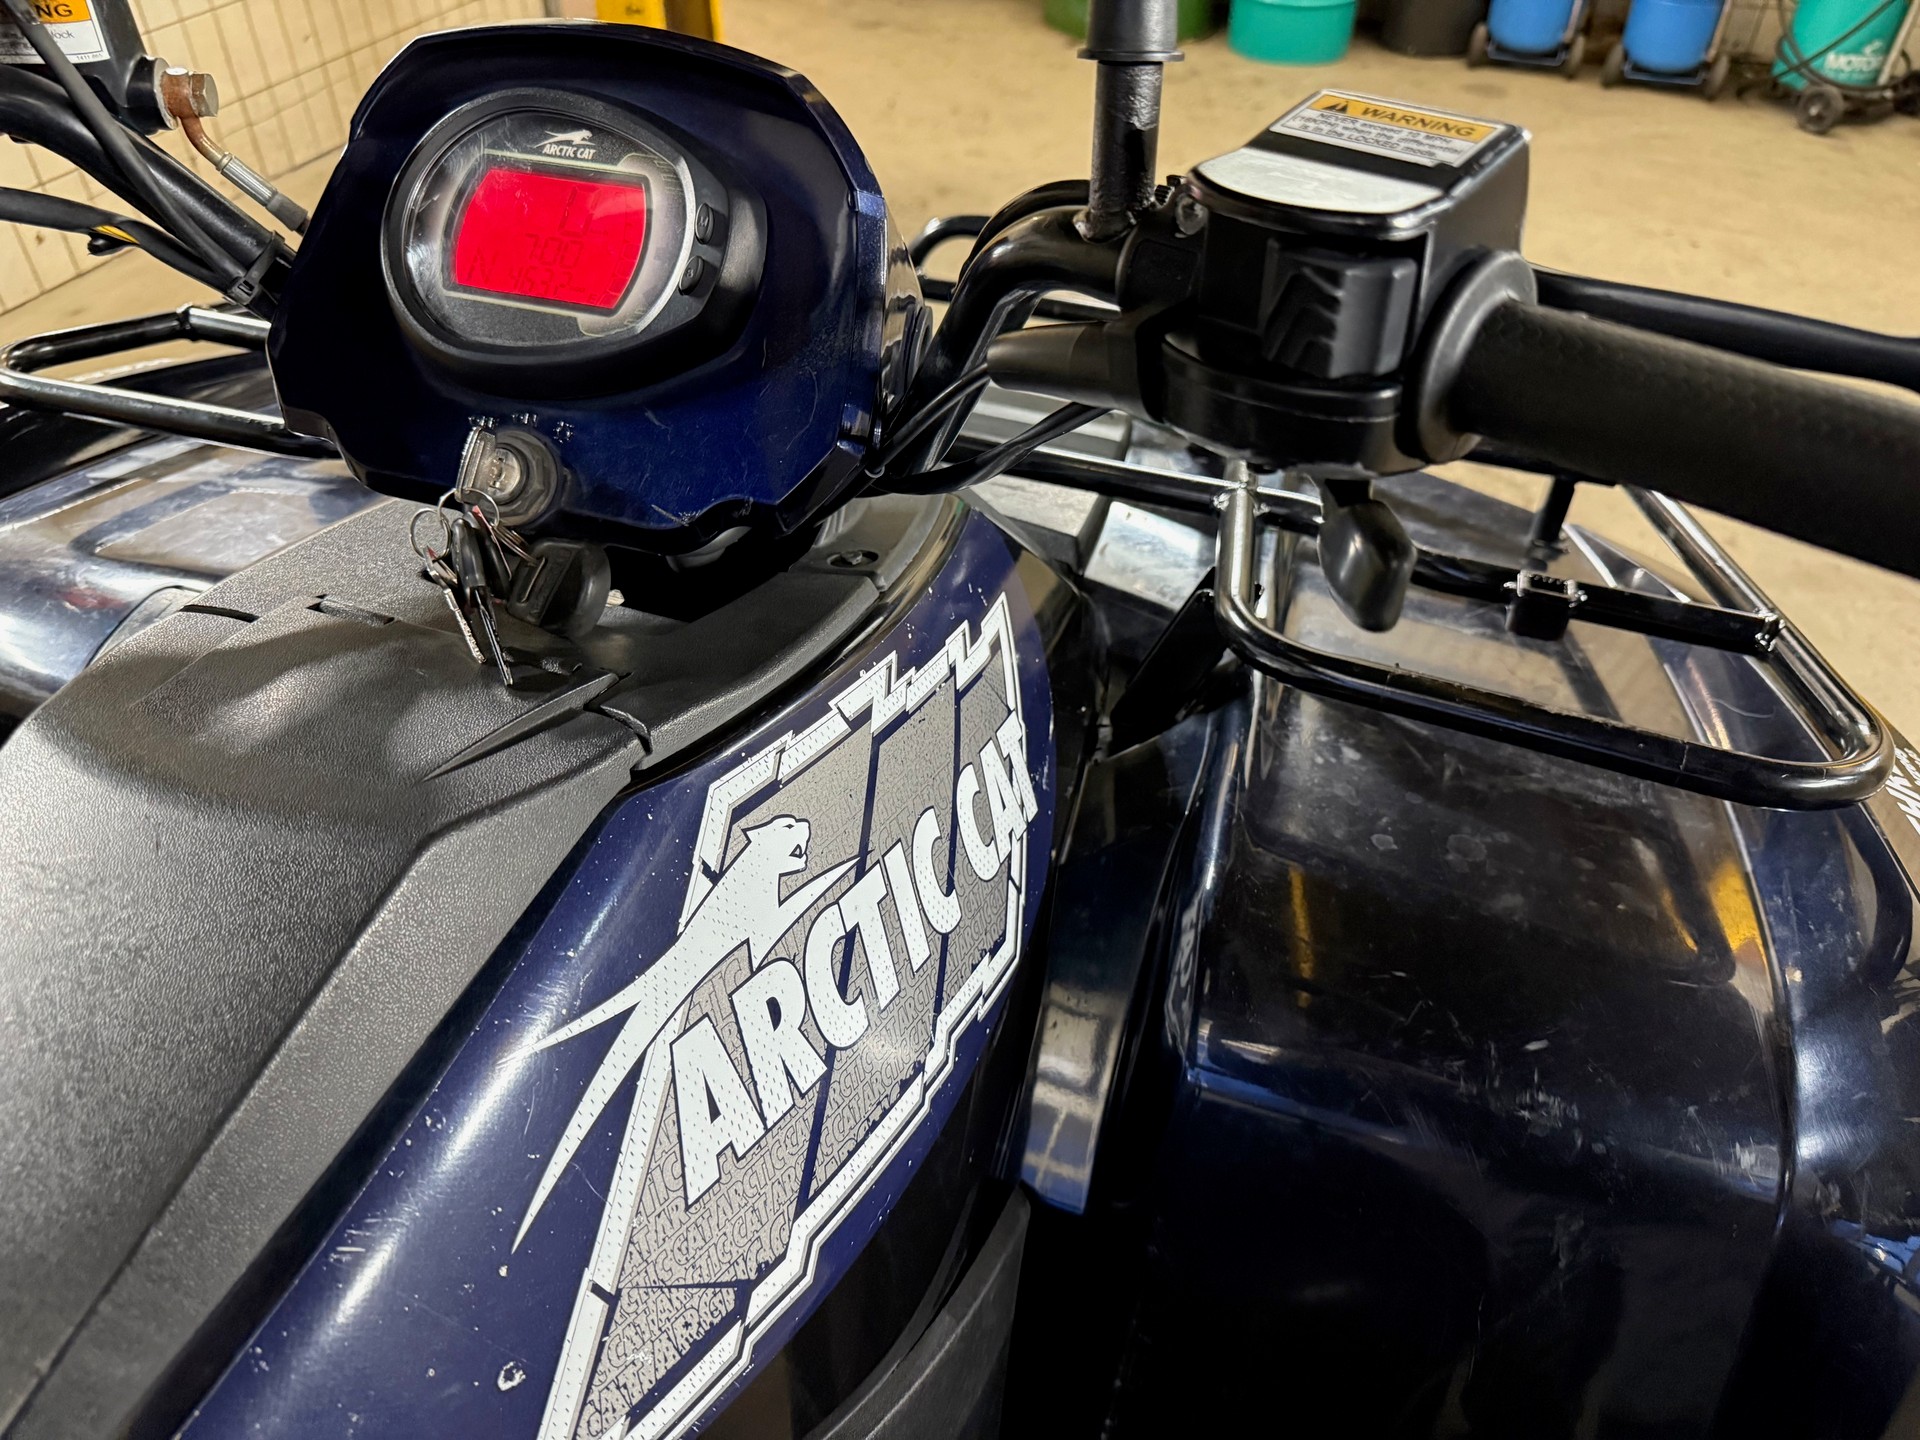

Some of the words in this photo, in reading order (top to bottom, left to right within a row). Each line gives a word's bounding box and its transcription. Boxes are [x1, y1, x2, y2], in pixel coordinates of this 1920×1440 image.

[1319, 113, 1359, 125] NEVER
[1361, 107, 1476, 137] WARNING
[1325, 129, 1346, 138] the
[1346, 134, 1401, 149] LOCKED
[1374, 131, 1395, 141] the
[542, 143, 578, 157] ARCTIC
[576, 148, 597, 160] CAT
[670, 806, 962, 1210] ARCTIC
[956, 709, 1039, 882] CAT
